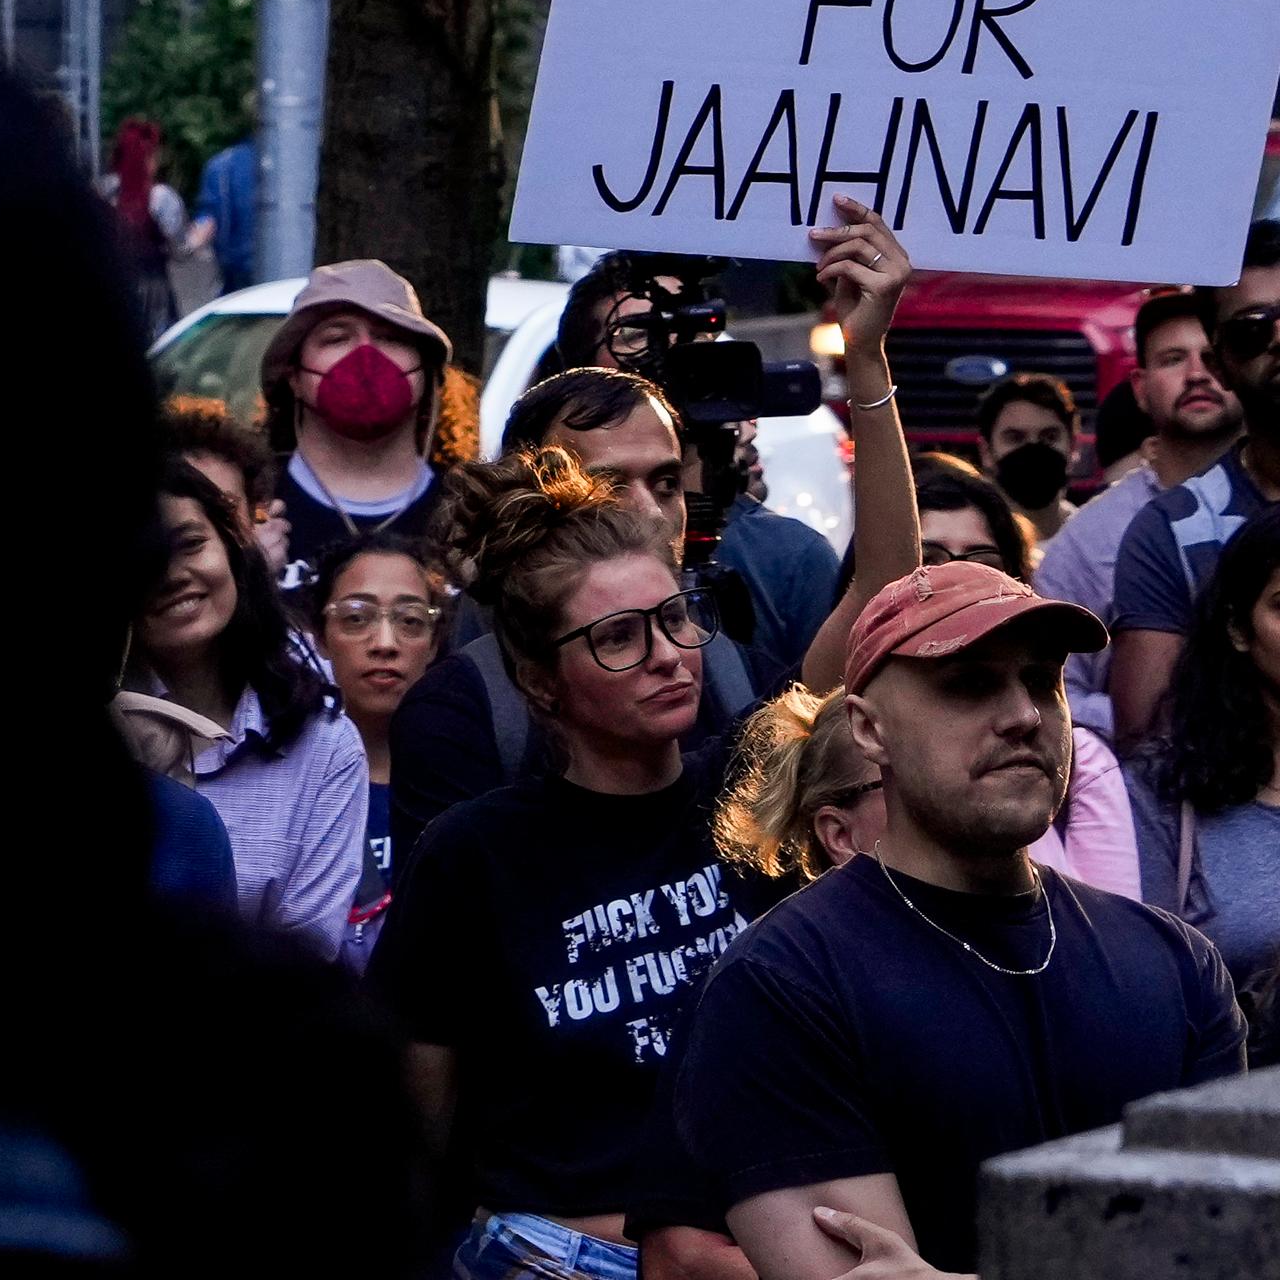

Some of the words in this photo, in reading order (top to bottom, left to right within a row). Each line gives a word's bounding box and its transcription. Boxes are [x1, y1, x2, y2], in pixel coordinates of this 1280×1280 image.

[592, 79, 1159, 247] JAAHNAVI
[561, 889, 660, 964] FUCK
[659, 863, 730, 926] YOU
[534, 966, 620, 1028] YOU
